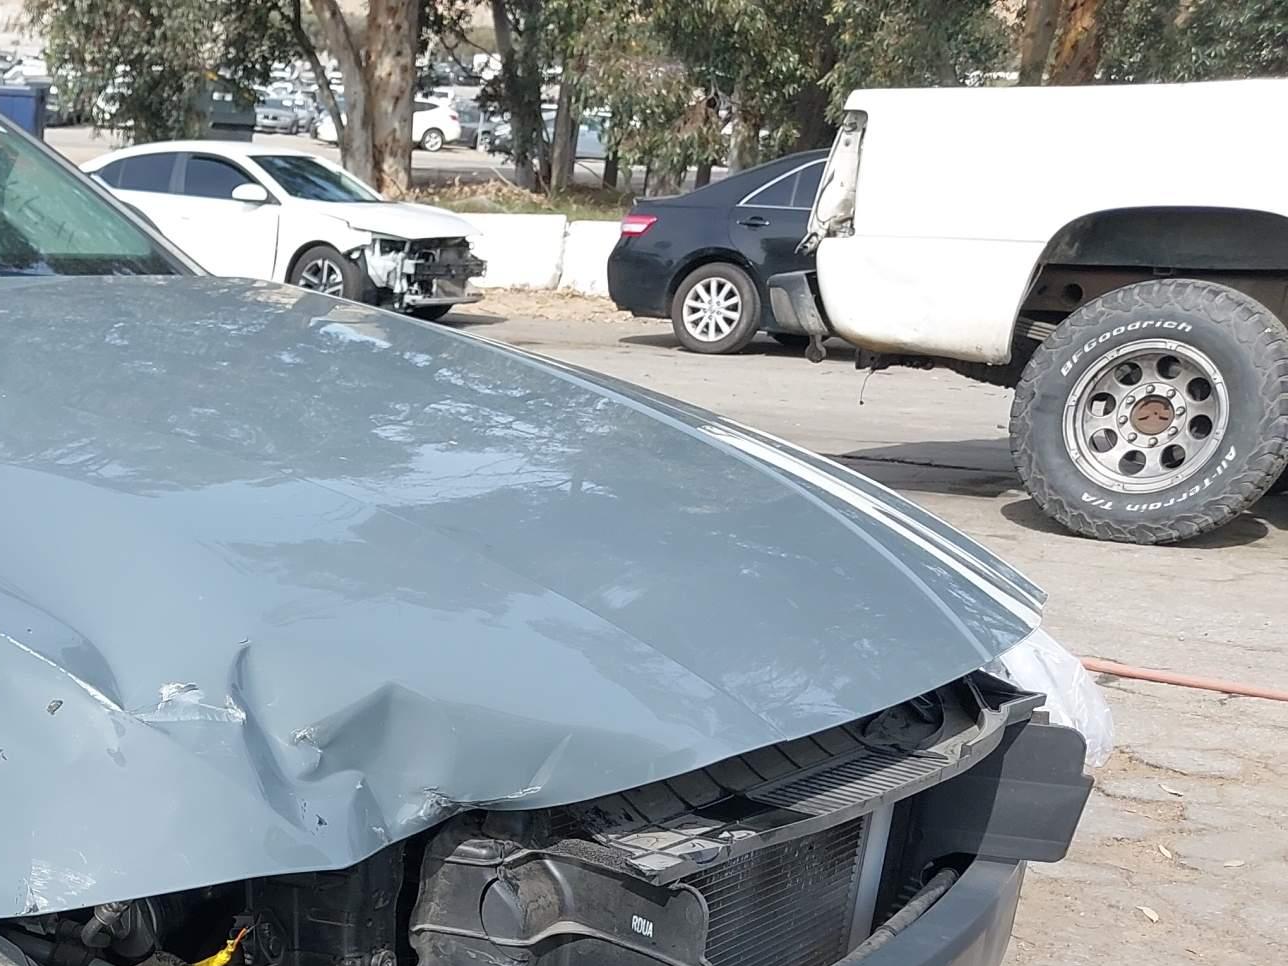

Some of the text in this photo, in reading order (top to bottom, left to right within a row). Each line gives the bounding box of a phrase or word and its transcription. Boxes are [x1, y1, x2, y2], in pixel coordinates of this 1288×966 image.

[1060, 319, 1193, 377] BFGoodrich
[1080, 445, 1237, 513] All-Terrain T/A
[631, 914, 654, 938] RDUA
